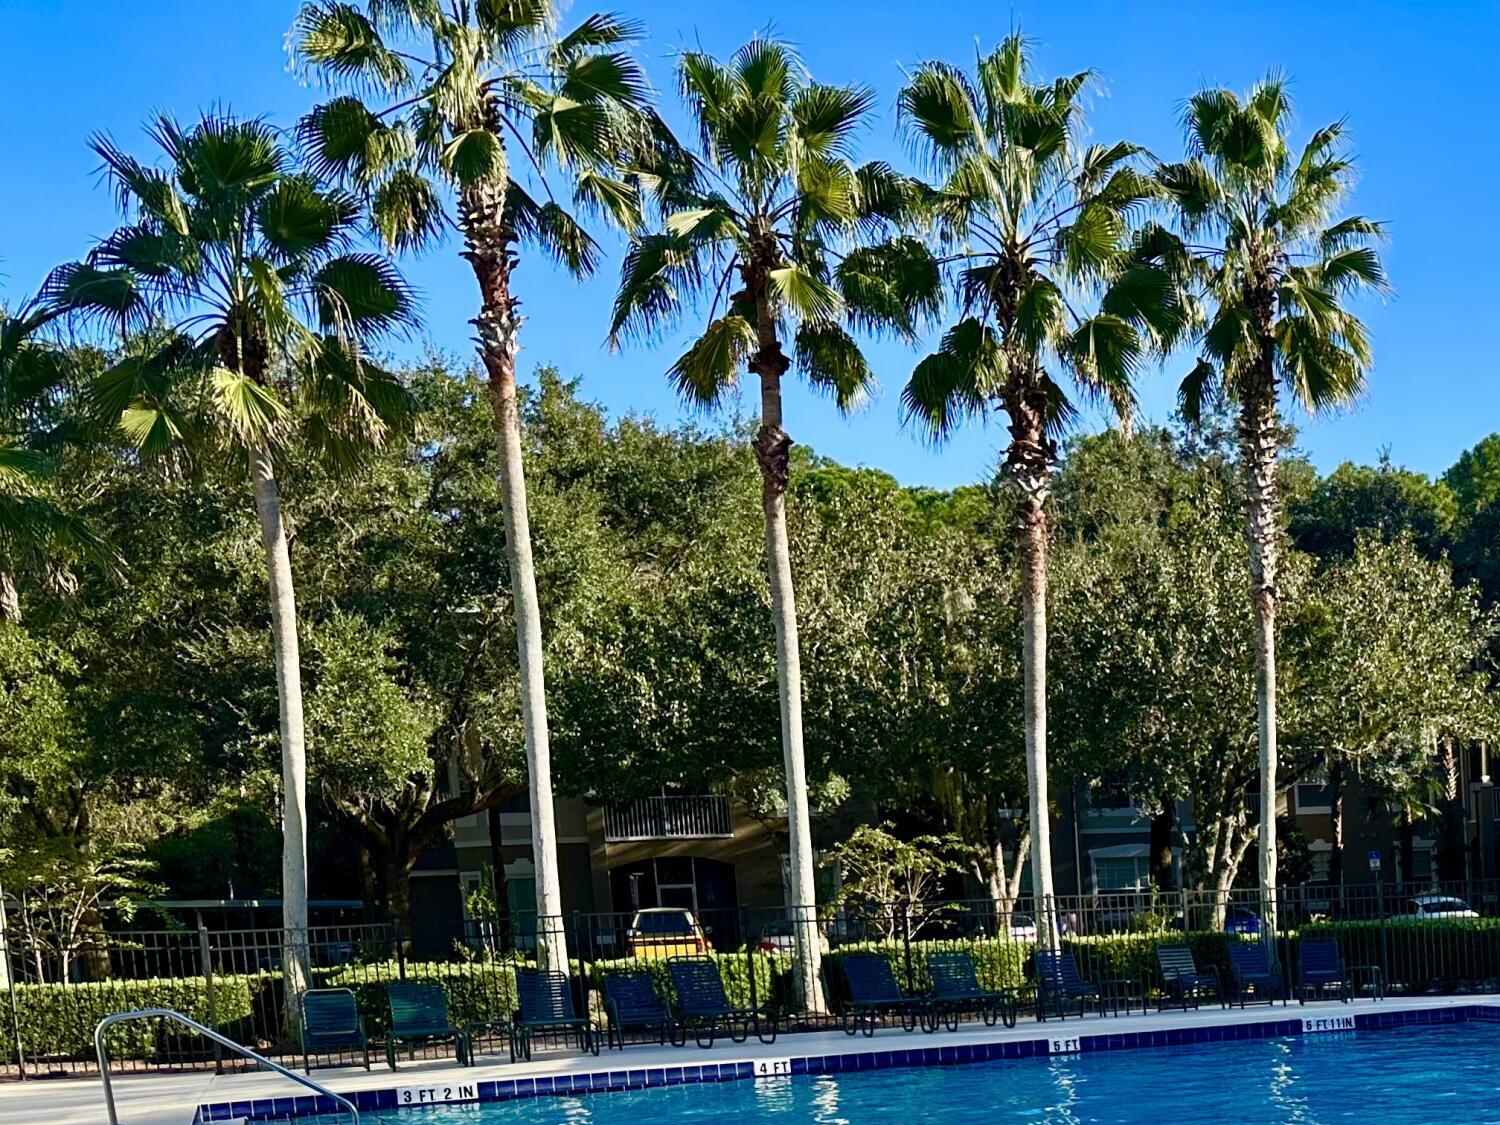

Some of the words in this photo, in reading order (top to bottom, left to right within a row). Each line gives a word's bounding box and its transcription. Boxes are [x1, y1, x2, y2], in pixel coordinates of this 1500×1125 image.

[1053, 1040, 1061, 1051] 5
[760, 1062, 767, 1074] 4
[774, 1061, 788, 1074] FT
[403, 1090, 412, 1103] 3
[419, 1088, 435, 1102] FT
[443, 1087, 452, 1100] 2
[458, 1085, 474, 1098] IN
